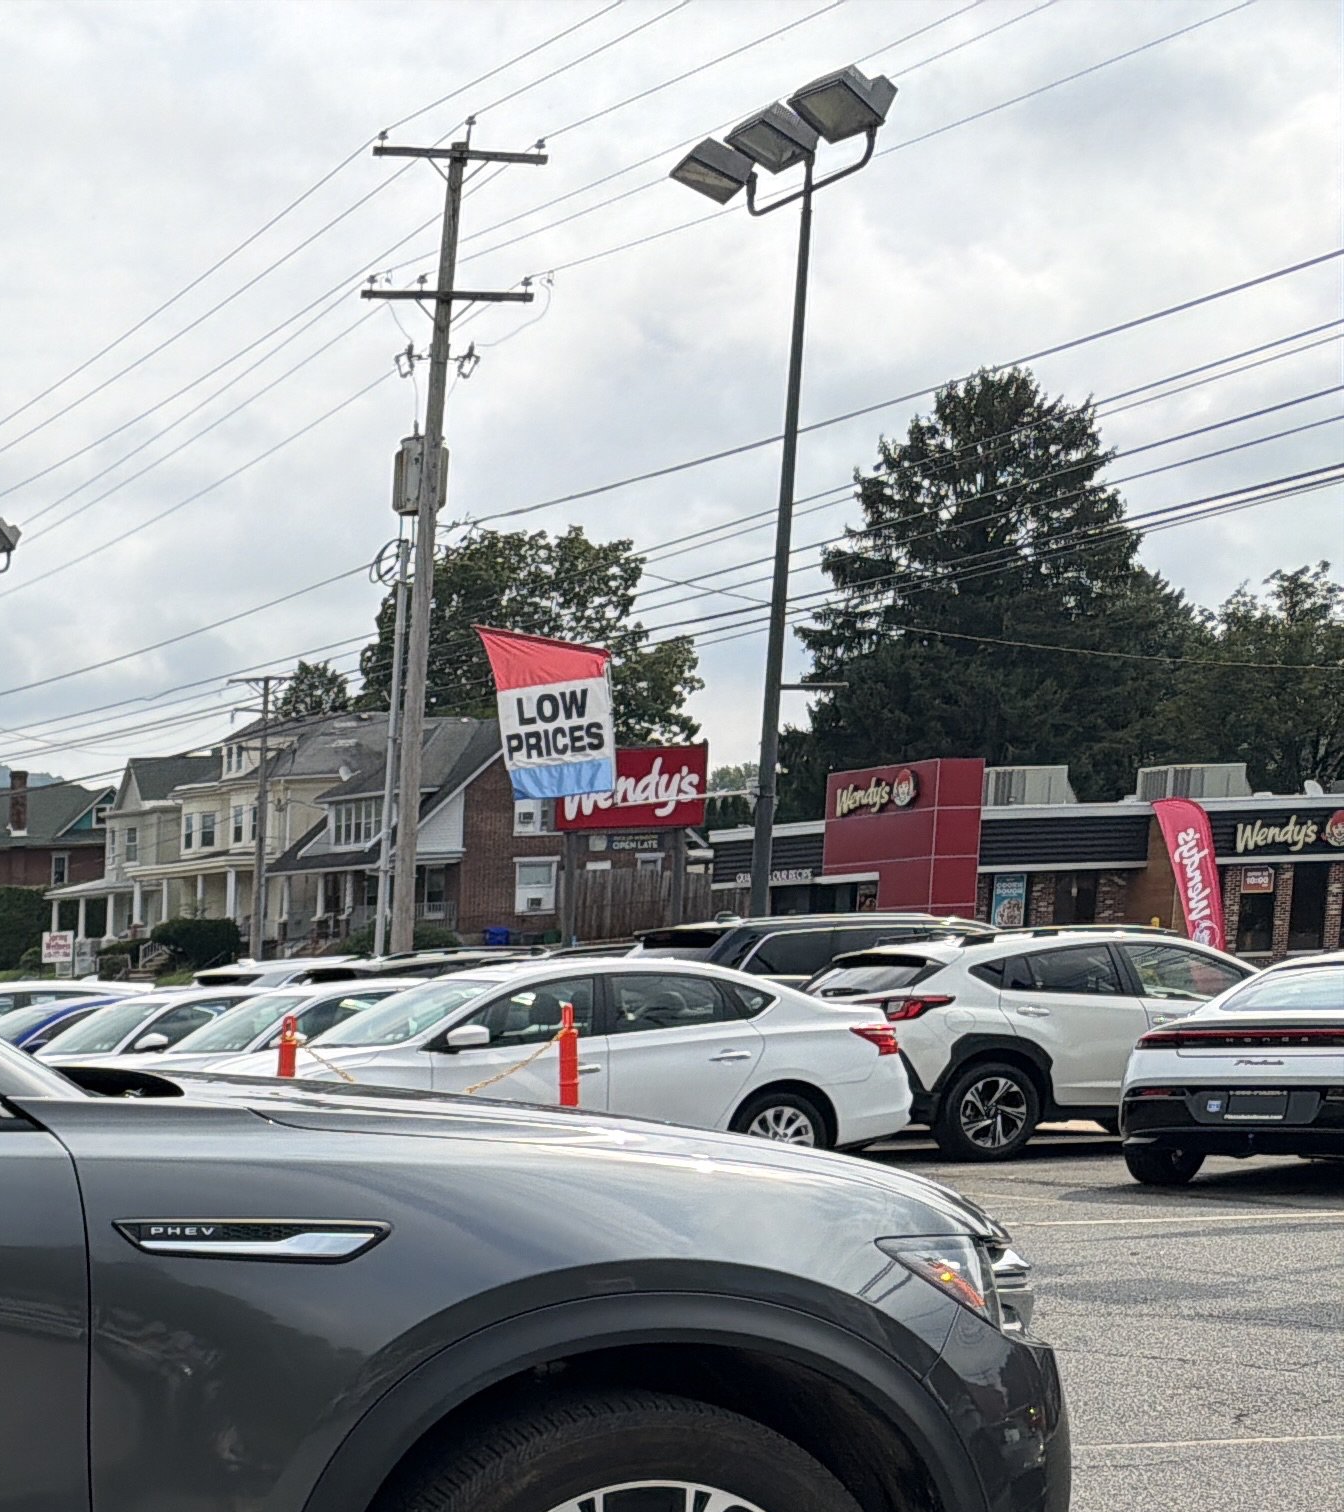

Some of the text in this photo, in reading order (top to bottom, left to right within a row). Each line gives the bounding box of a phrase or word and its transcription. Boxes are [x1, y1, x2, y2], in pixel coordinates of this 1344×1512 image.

[516, 688, 589, 726] LOW
[505, 722, 605, 762] PRICES
[564, 757, 700, 821] Wendy's
[835, 779, 889, 818] Wendy's
[637, 839, 658, 849] LATE
[1236, 815, 1318, 854] Wendy's
[150, 1226, 216, 1236] PHEV
